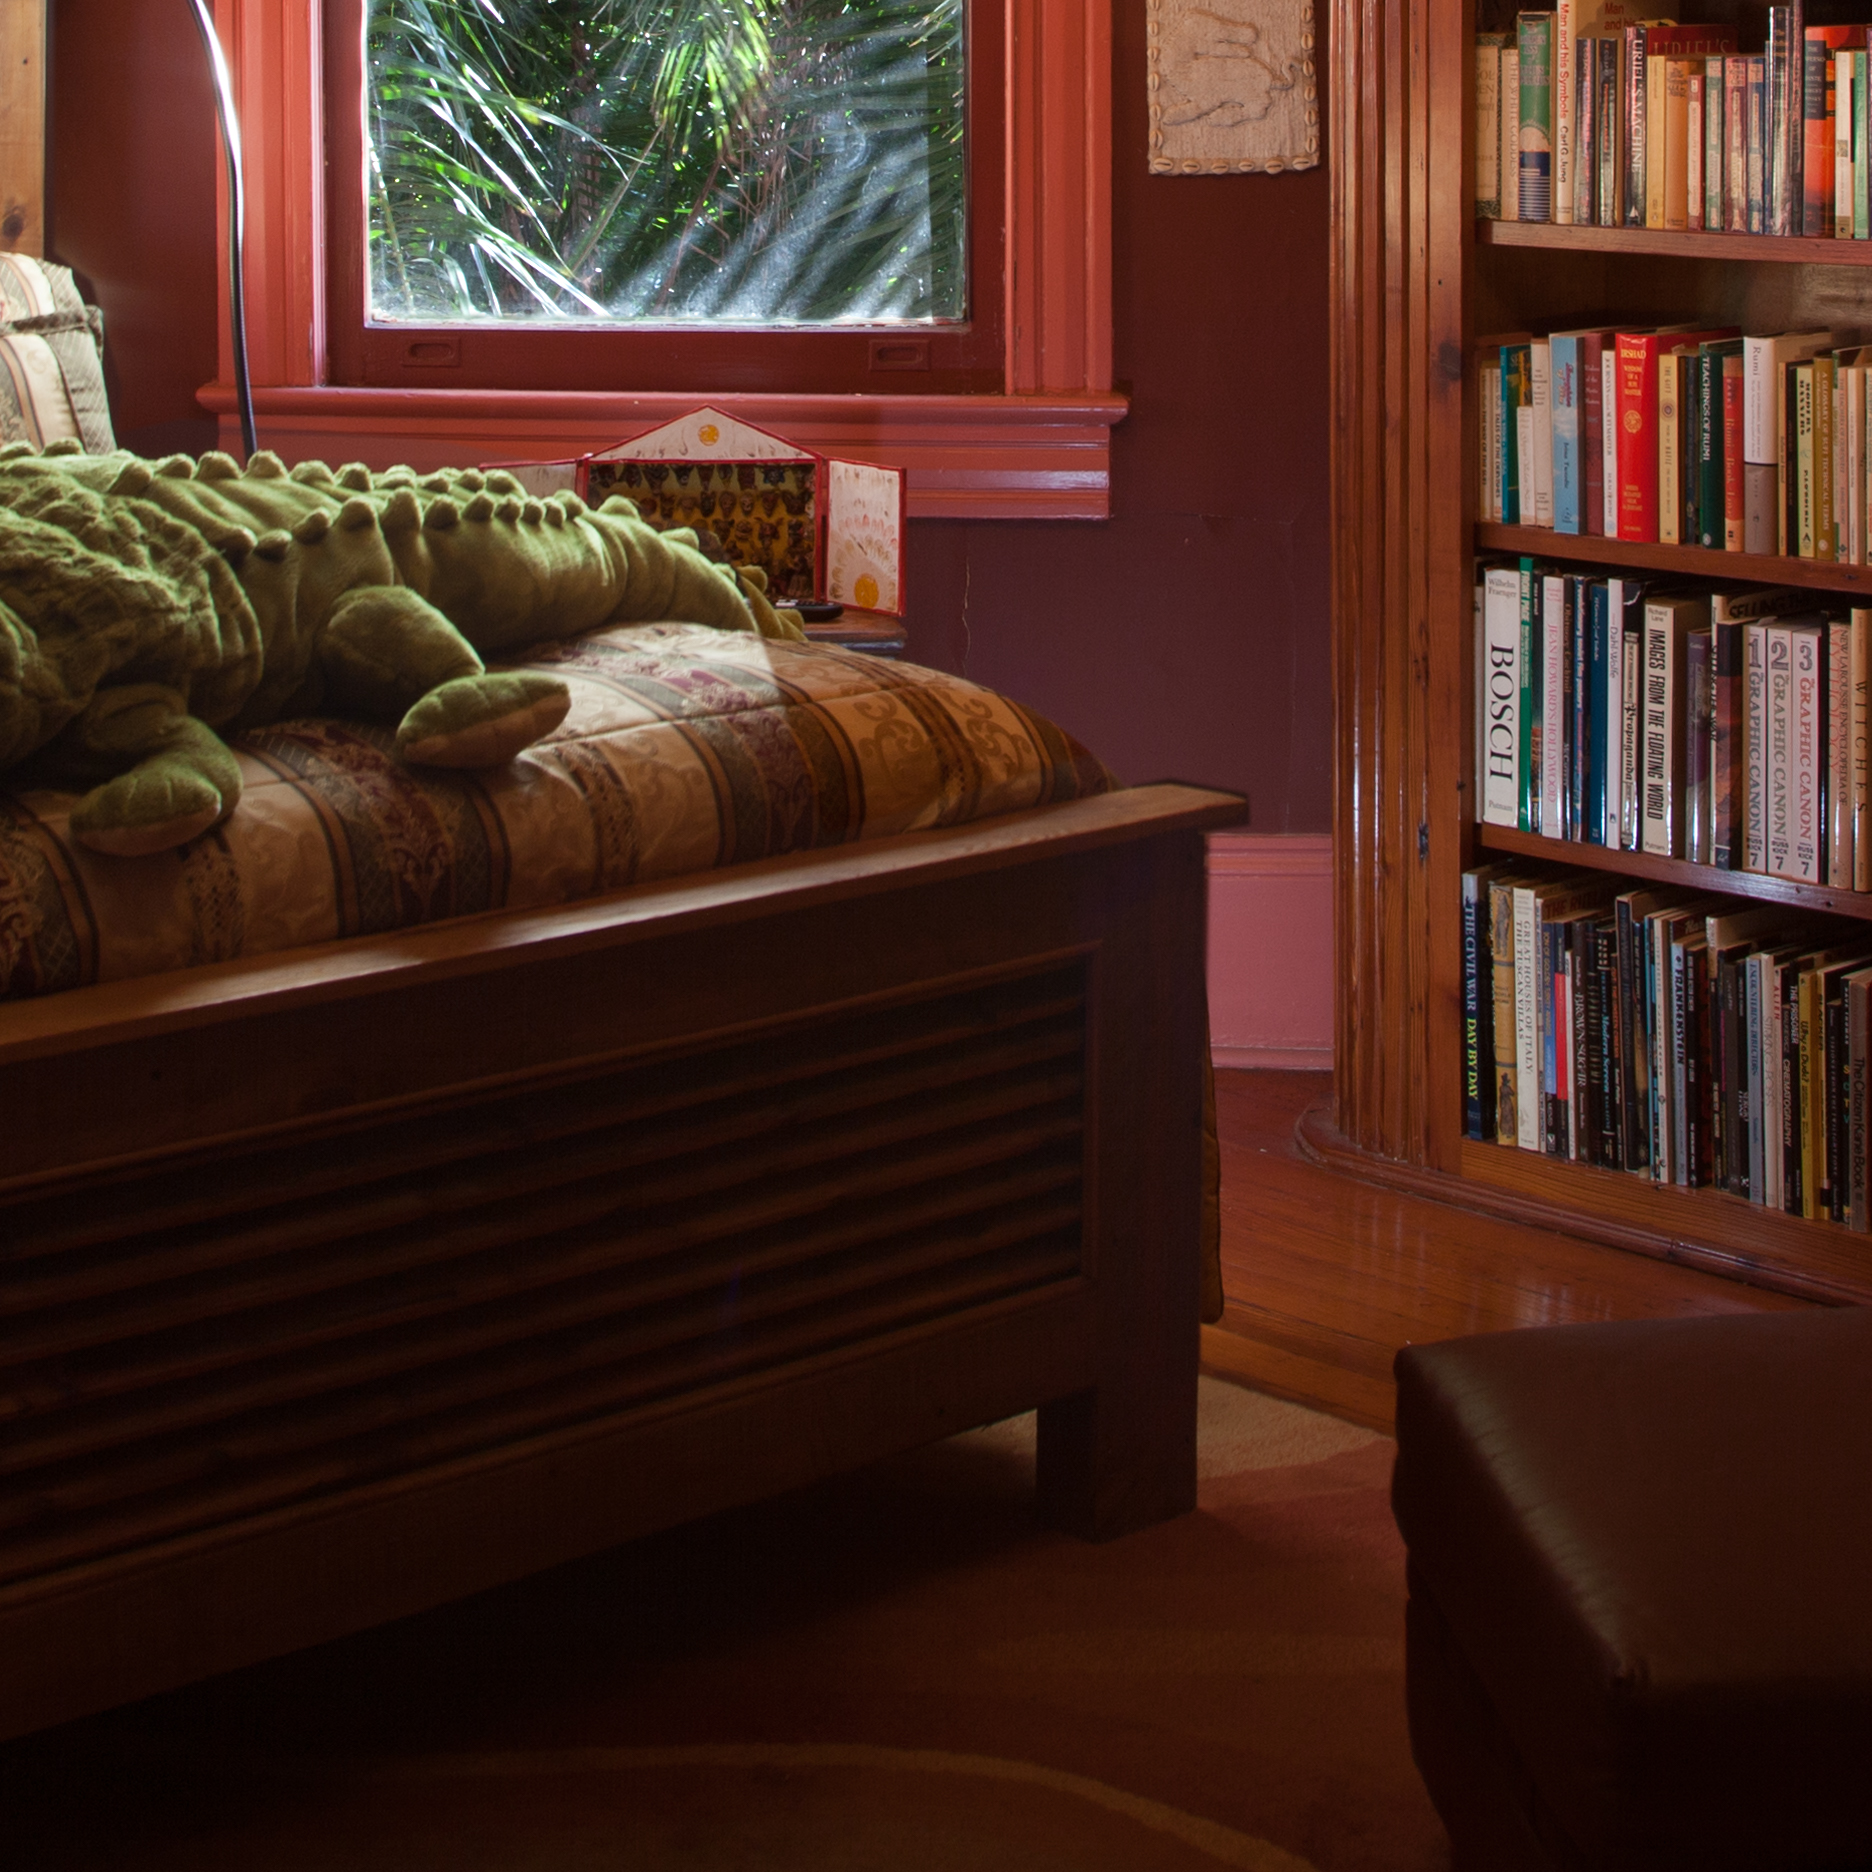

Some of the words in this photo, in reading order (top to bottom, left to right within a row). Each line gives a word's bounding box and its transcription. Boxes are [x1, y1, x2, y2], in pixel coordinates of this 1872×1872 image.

[1559, 3, 1570, 27] Man
[1559, 29, 1570, 50] and
[1559, 53, 1570, 68] his
[1558, 70, 1570, 119] Symbols
[1559, 126, 1568, 145] Carl
[1558, 158, 1568, 183] Jung
[1751, 346, 1762, 376] Rumi
[1701, 356, 1711, 420] TEACHINGS
[1702, 420, 1711, 432] OF
[1702, 433, 1711, 461] RUMI
[1547, 624, 1559, 654] JEAN
[1648, 629, 1666, 669] IMAGES
[1770, 640, 1789, 671] 2
[1799, 644, 1813, 672] 3
[1547, 656, 1559, 720] HOWARD'S
[1648, 674, 1666, 705] FROM
[1489, 642, 1515, 783] BOSCH
[1648, 709, 1665, 728] THE
[1748, 672, 1762, 757] GRAPHIC
[1773, 674, 1787, 762] GRAPHIC
[1799, 677, 1812, 767] GRAPHIC
[1624, 704, 1636, 781] Propaganda
[1647, 731, 1665, 778] FLOATING
[1855, 680, 1868, 813] WITCHES
[1547, 722, 1559, 803] HOLLYWOOD
[1646, 783, 1665, 820] WORLD
[1748, 765, 1761, 834] CANON
[1773, 767, 1786, 836] CANON
[1799, 771, 1812, 840] CANON
[1464, 906, 1476, 937] THE
[1465, 937, 1477, 977] CIVIL
[1466, 978, 1477, 1011] WAR
[1789, 985, 1798, 1001] THE
[1466, 1018, 1477, 1046] DAY
[1601, 1014, 1611, 1055] Modern
[1674, 968, 1685, 1065] FRANKENSTEIN
[1789, 1002, 1800, 1044] PRISONER
[1466, 1049, 1478, 1068] BY
[1602, 1056, 1611, 1093] Screen
[1853, 1057, 1865, 1081] The
[1467, 1069, 1479, 1101] DAY
[1782, 1058, 1792, 1148] CINEMATOGRAPHY
[1852, 1082, 1865, 1123] Citizen
[1853, 1123, 1866, 1156] Kane
[1853, 1156, 1866, 1189] Book
